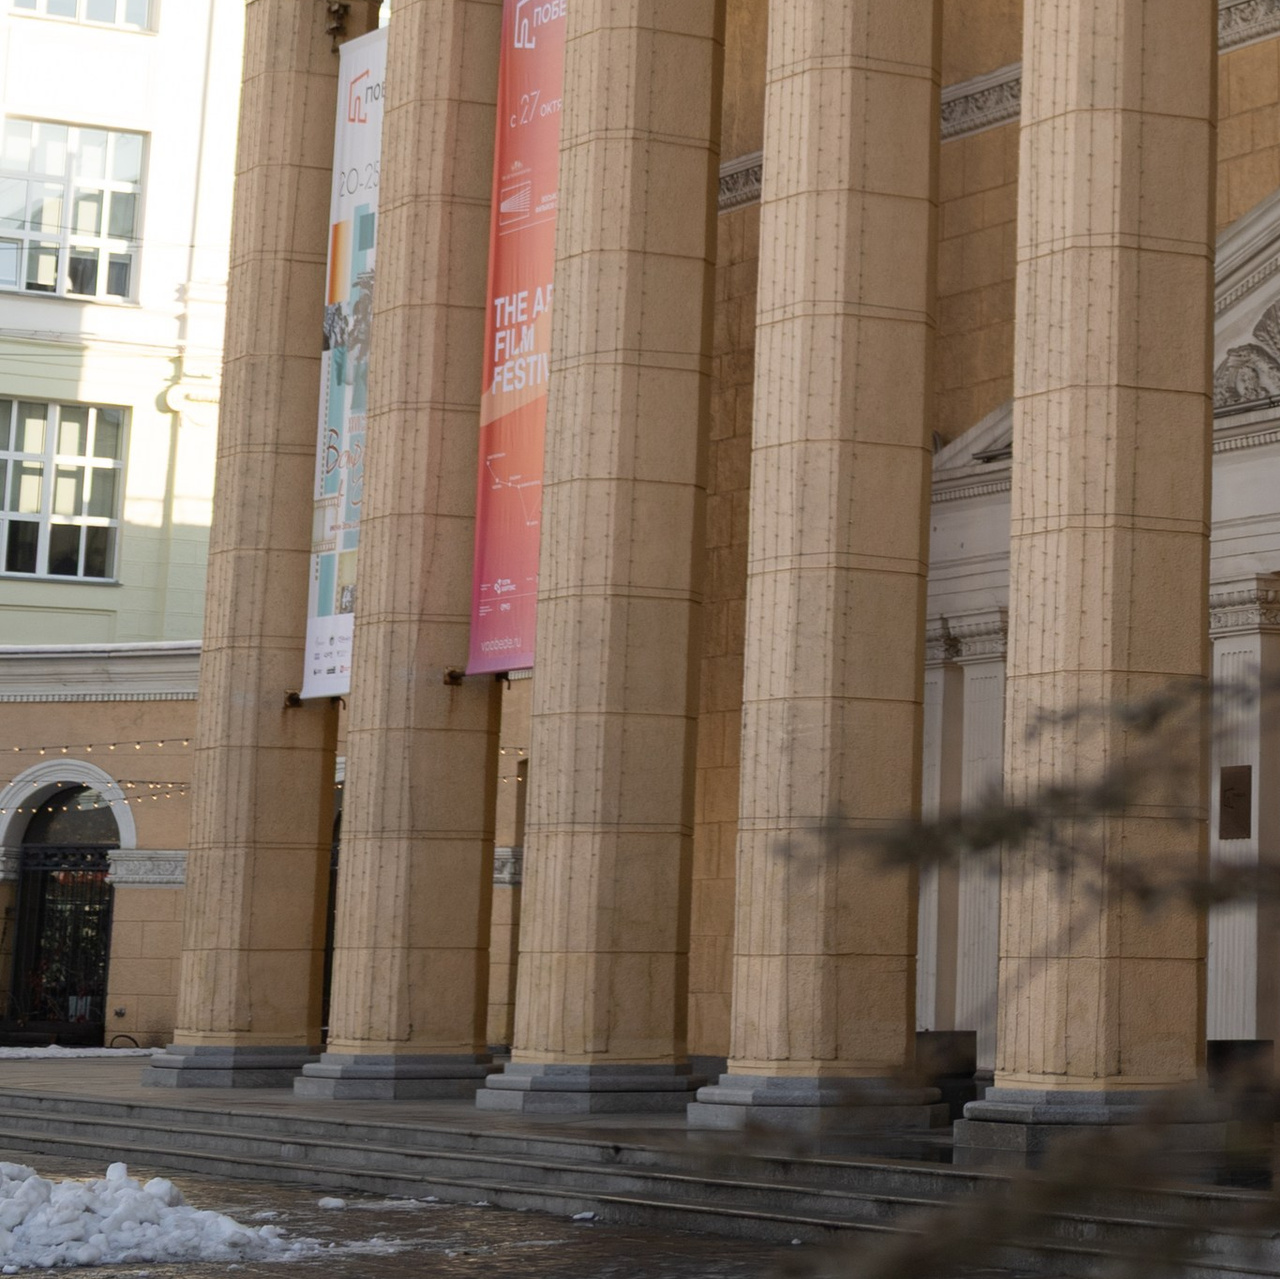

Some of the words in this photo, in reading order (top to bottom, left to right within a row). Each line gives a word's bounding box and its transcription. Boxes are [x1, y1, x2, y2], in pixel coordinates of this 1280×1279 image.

[520, 89, 541, 125] 27
[494, 290, 528, 328] THE
[494, 323, 535, 362] FILM
